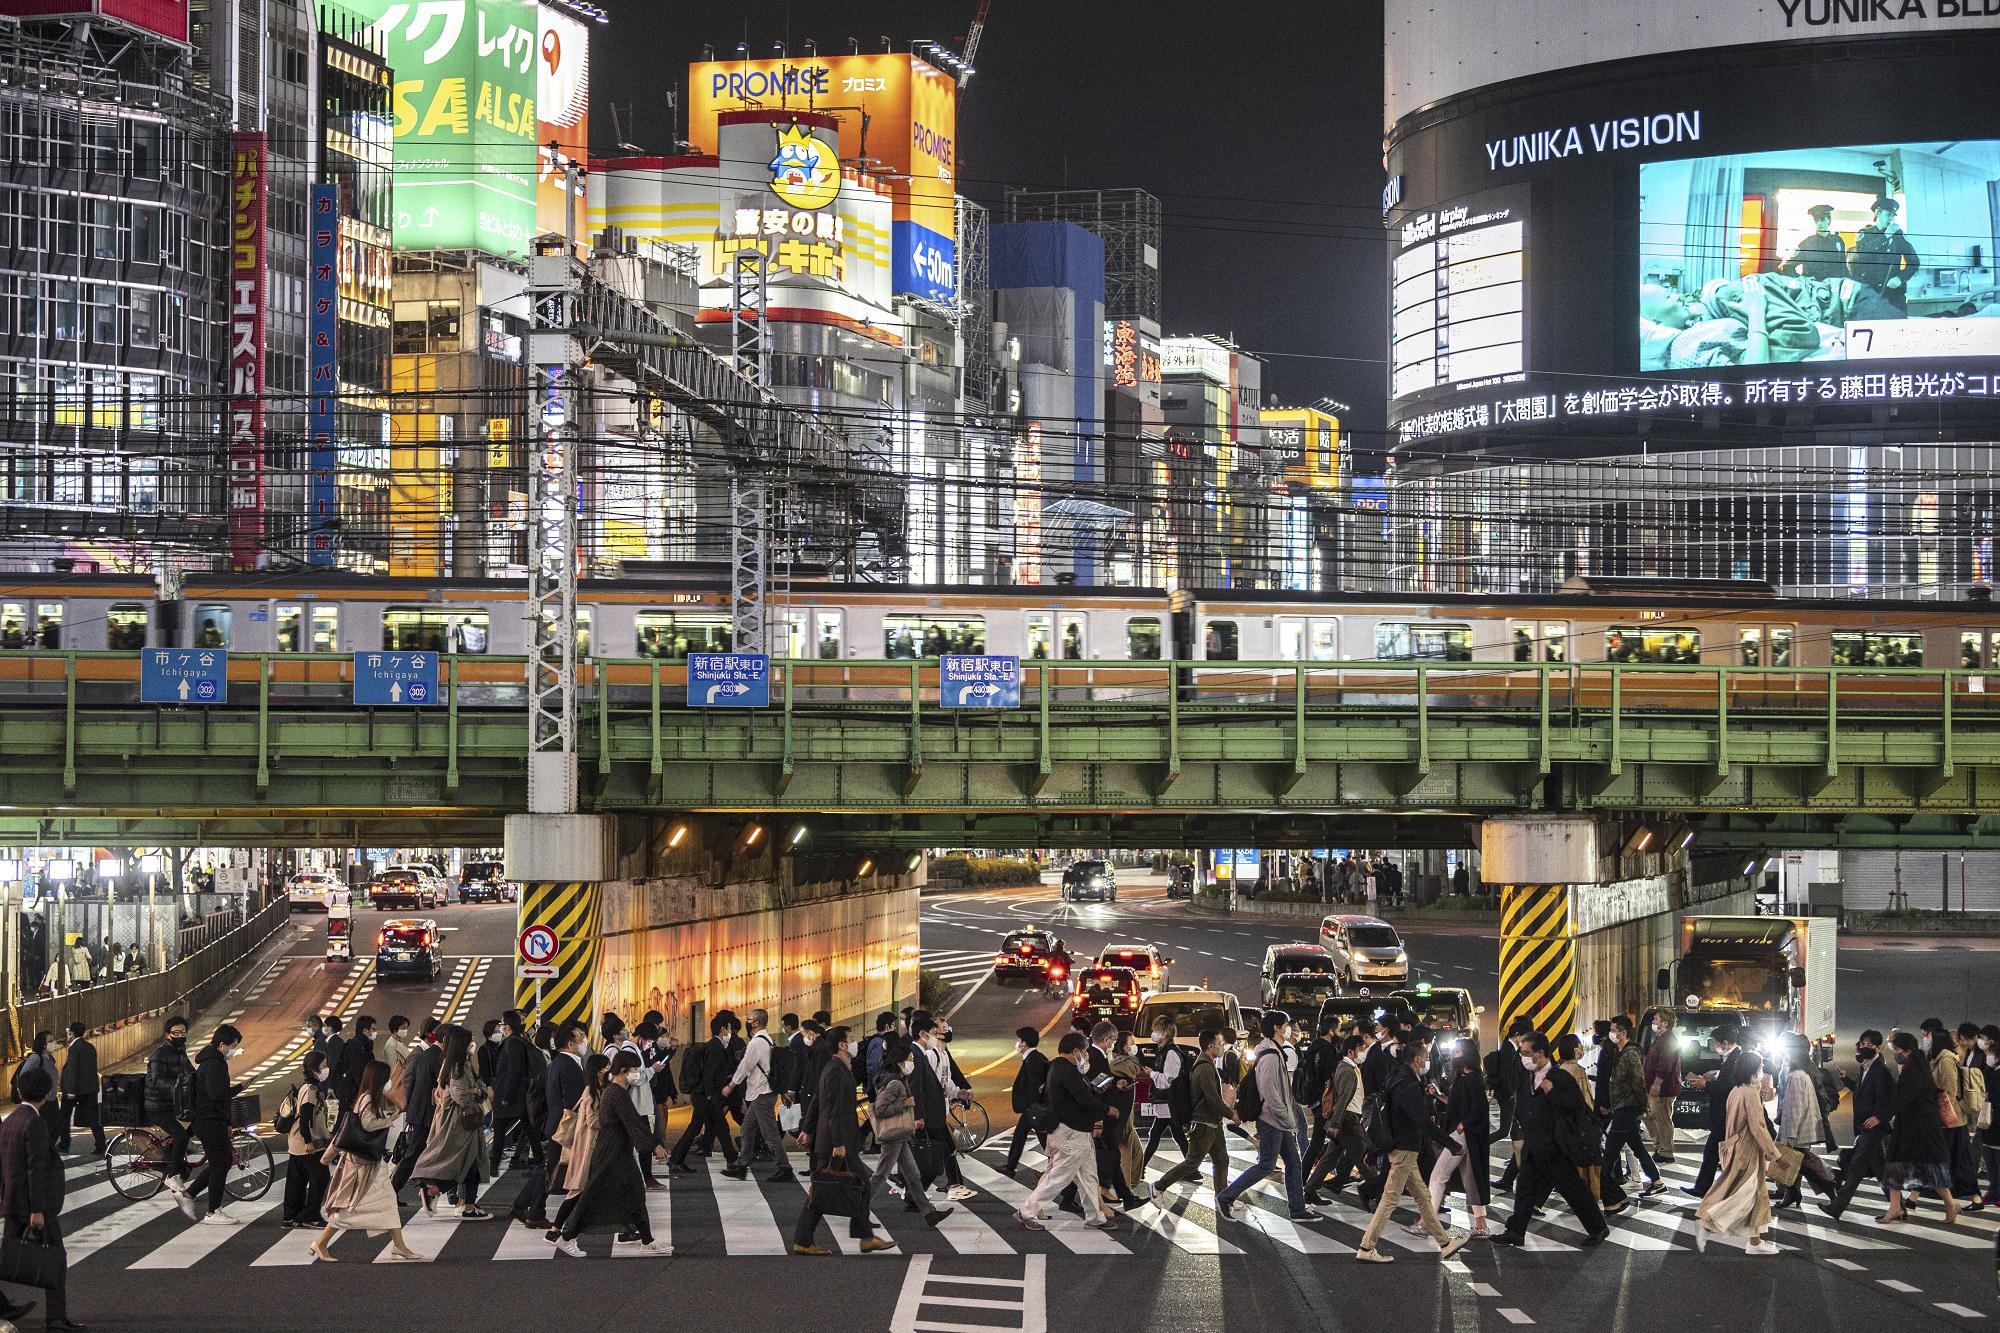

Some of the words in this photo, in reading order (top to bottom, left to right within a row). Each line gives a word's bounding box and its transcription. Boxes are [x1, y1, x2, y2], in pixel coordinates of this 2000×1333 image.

[1776, 0, 1928, 28] YUNIKA
[478, 9, 534, 74] レイク
[712, 69, 829, 99] PROMISE
[841, 76, 887, 93] プロミス
[475, 80, 535, 141] ALSA
[913, 121, 952, 167] PROMISE
[1485, 127, 1584, 171] YUNIKA
[1589, 110, 1701, 152] VISION
[927, 247, 953, 289] 50m
[694, 656, 763, 671] 新宿駅東口
[946, 657, 1014, 673] 新宿駅東口
[161, 668, 207, 679] Ichigaya
[374, 671, 419, 681] Ichigaya
[697, 671, 732, 681] Shinjuku
[948, 673, 983, 683] Shinjuku
[200, 684, 213, 695] 302
[411, 686, 425, 697] 302
[721, 684, 734, 694] 430
[973, 685, 987, 695] 430
